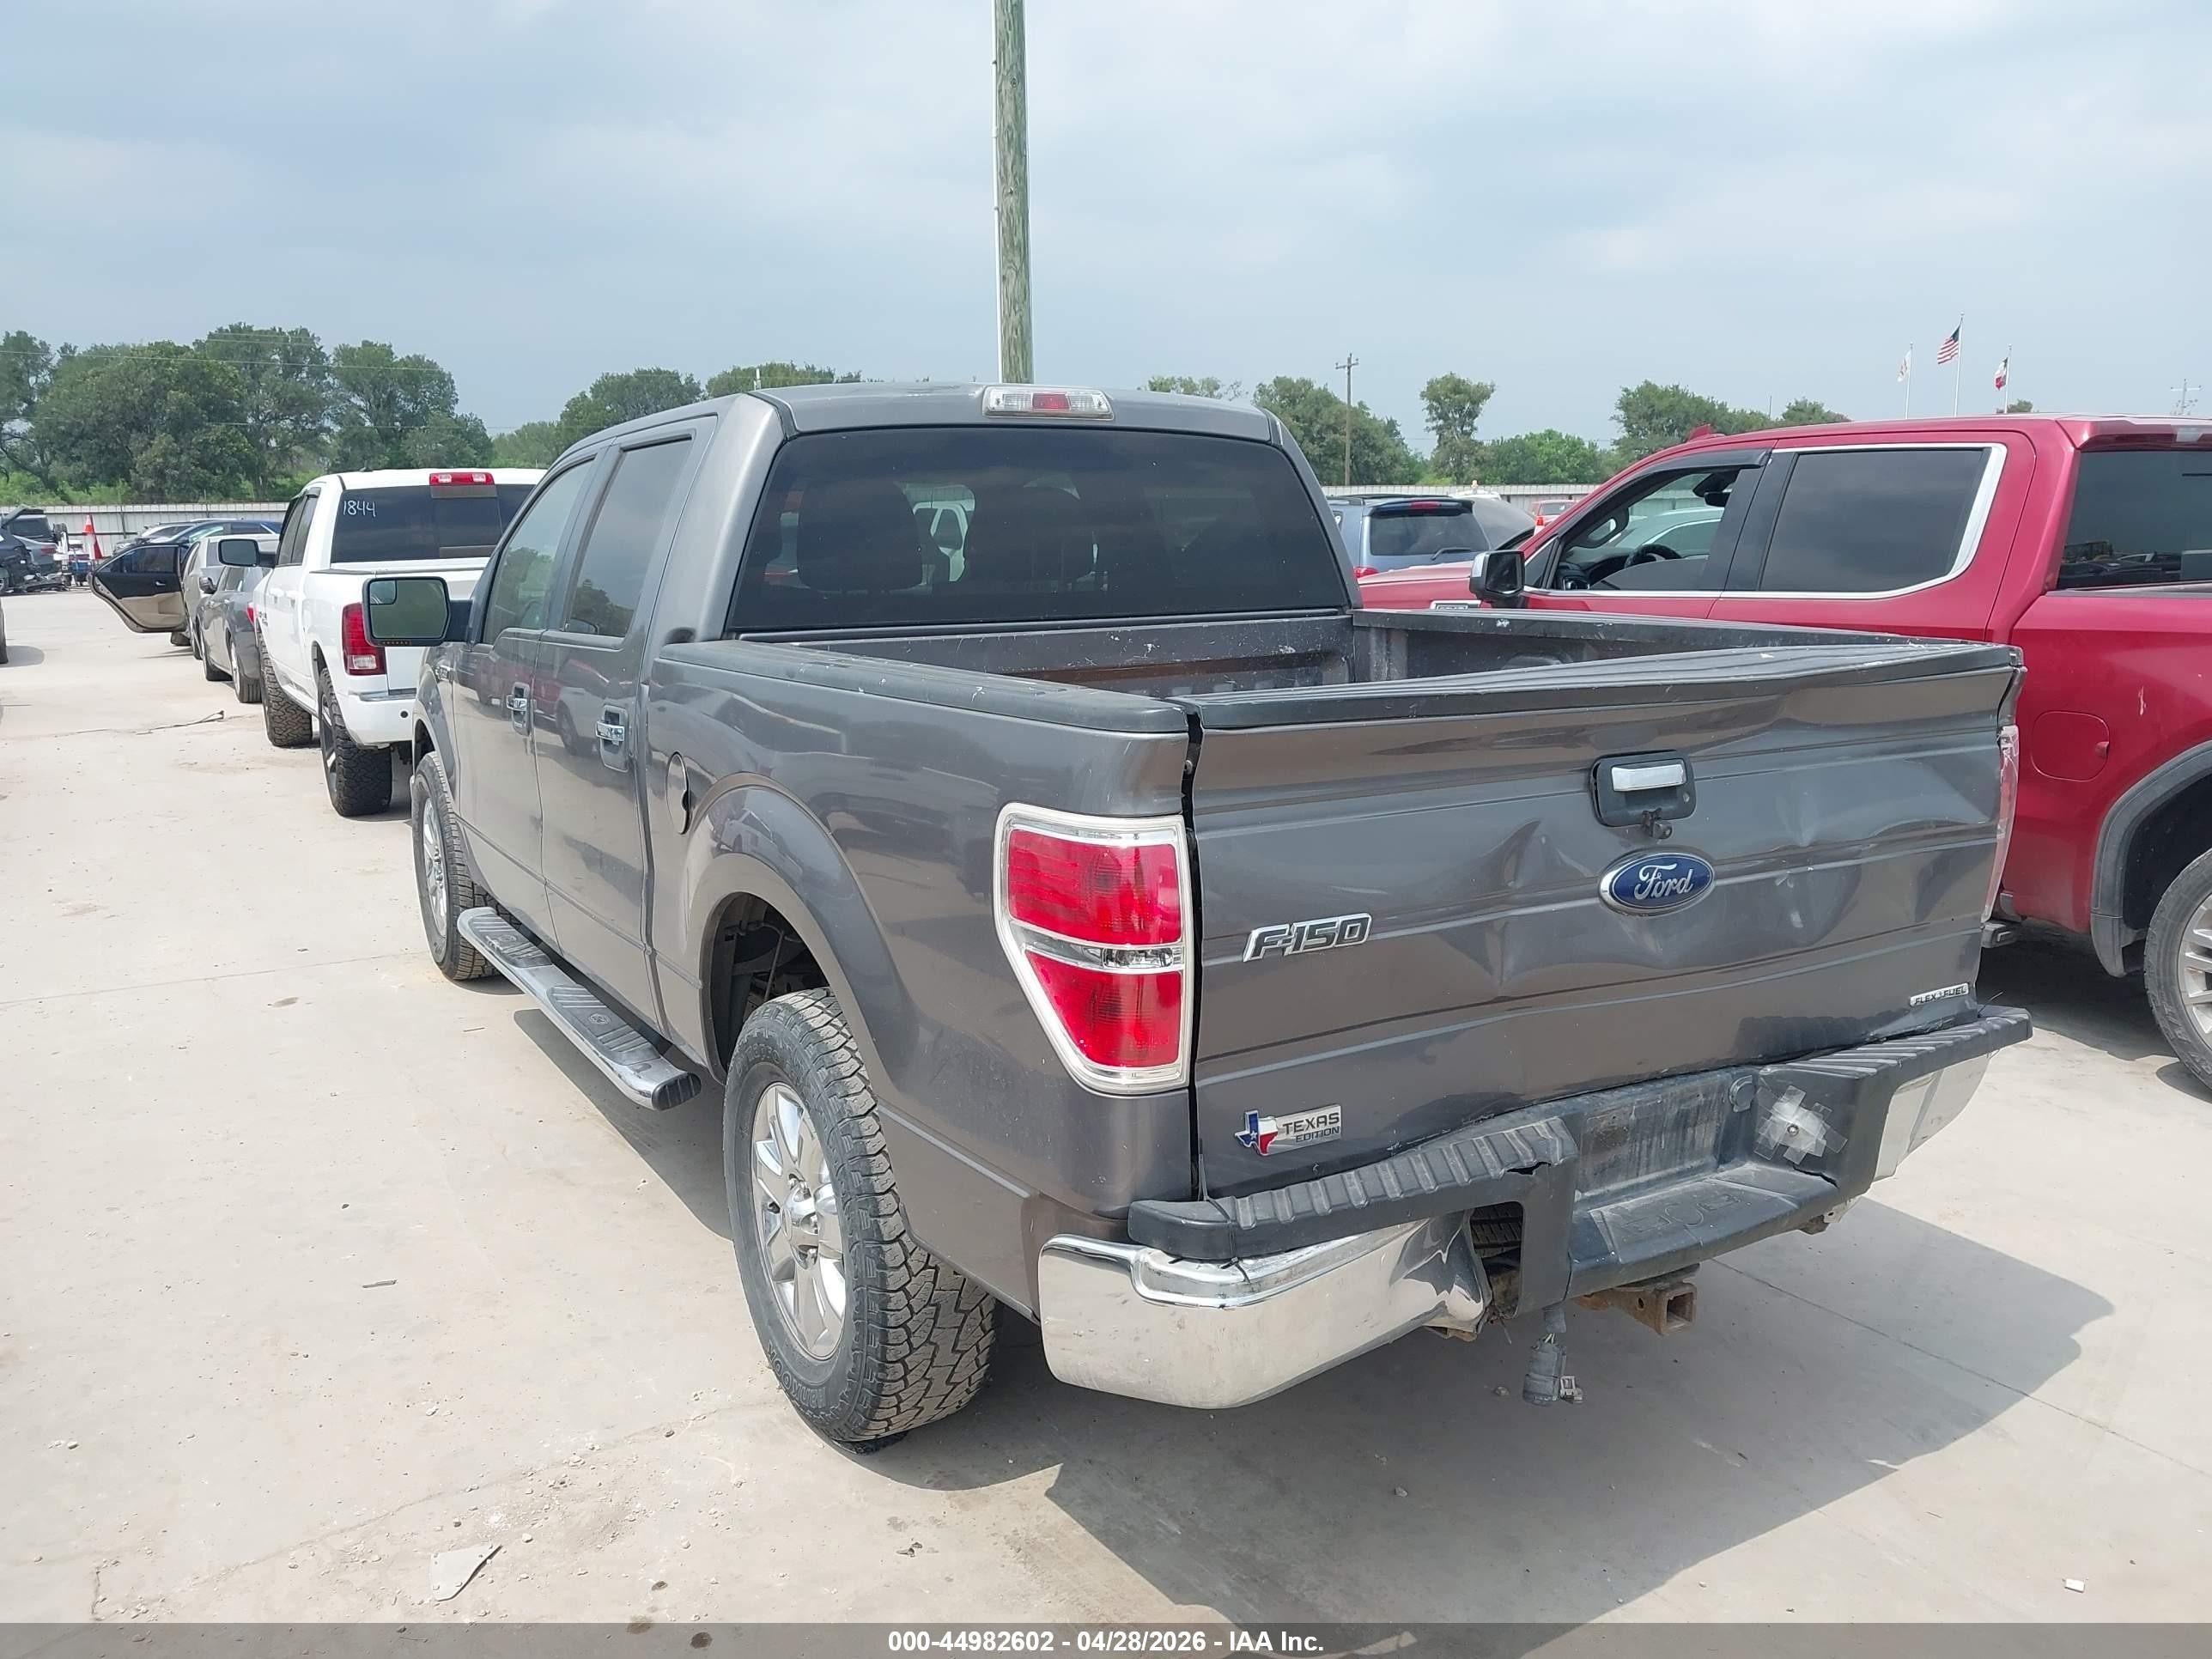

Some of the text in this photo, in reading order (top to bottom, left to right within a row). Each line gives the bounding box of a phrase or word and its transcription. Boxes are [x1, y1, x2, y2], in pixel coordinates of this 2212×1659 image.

[343, 501, 376, 517] 1844
[1634, 863, 1693, 900] Ford
[1243, 913, 1371, 962] F-150
[1915, 986, 1966, 1005] FLEX FUEL
[1282, 1112, 1340, 1134] TEXAS
[1296, 1126, 1340, 1143] EDITION
